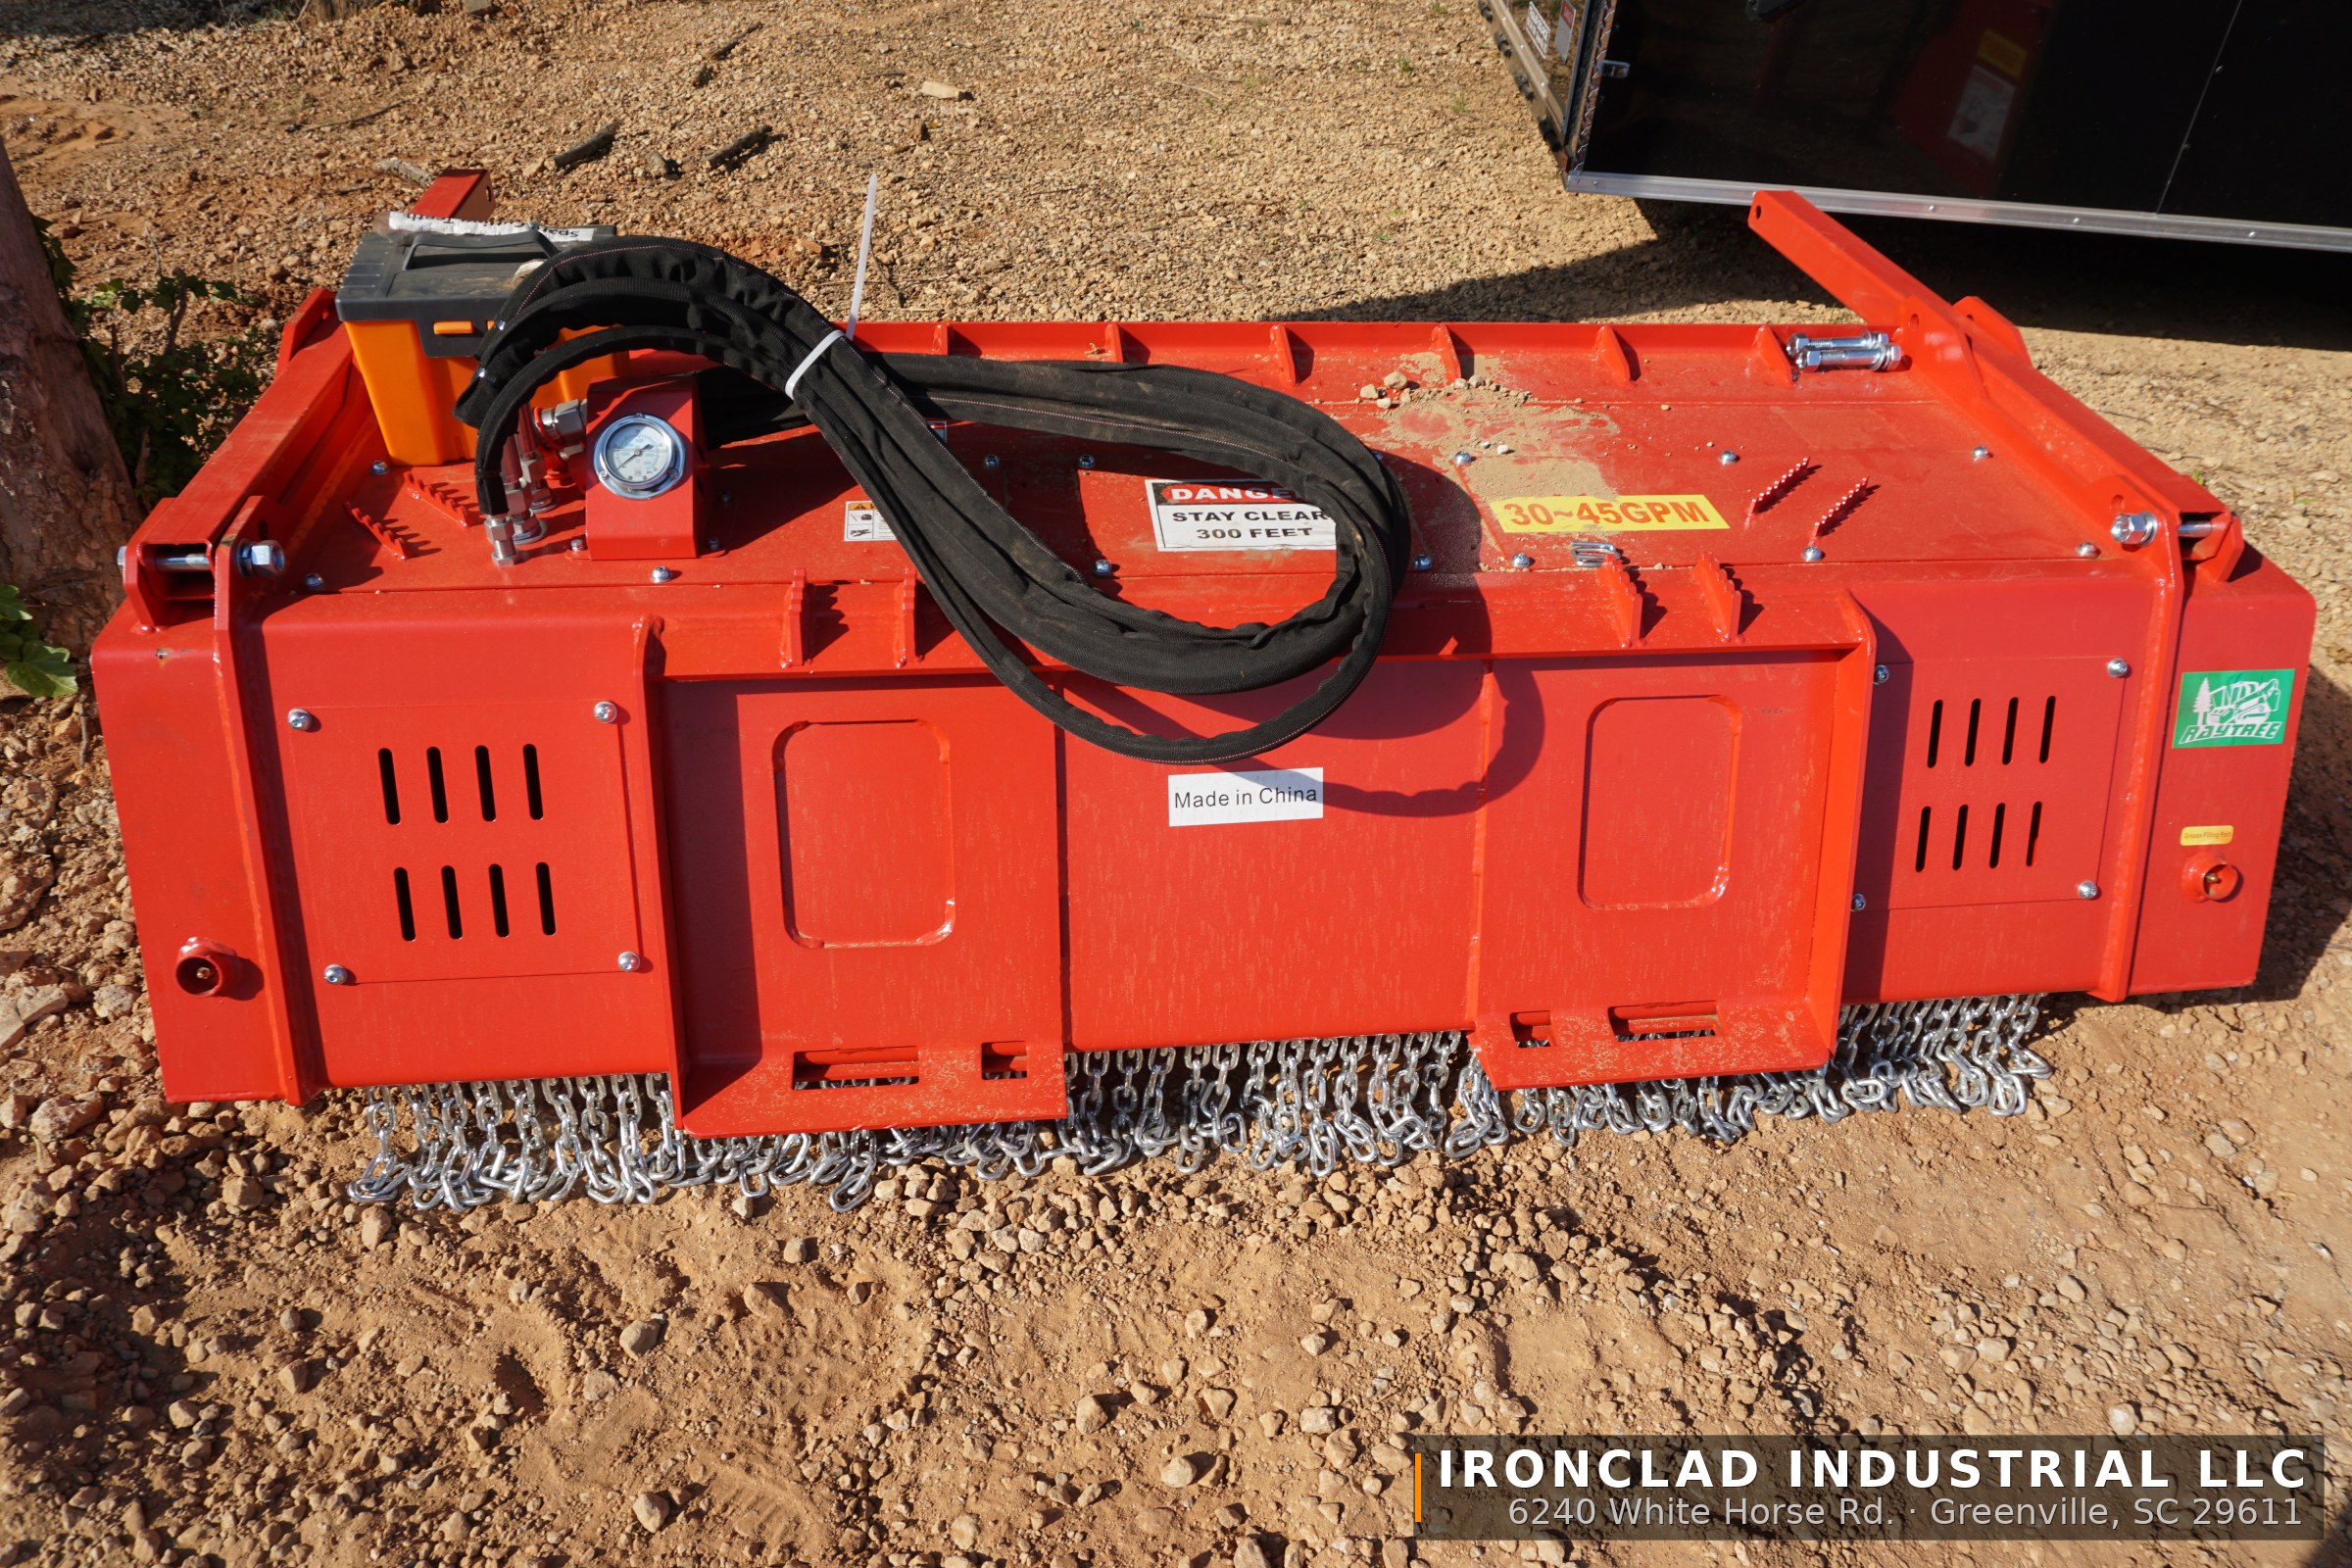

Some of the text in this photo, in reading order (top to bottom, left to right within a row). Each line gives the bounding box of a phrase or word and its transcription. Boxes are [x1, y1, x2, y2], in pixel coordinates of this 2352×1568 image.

[1170, 487, 1301, 501] DANGE
[1172, 511, 1329, 522] STAY CLEAR
[1504, 502, 1710, 526] 30~45GPM
[1197, 527, 1312, 540] 300 FEET
[1175, 786, 1317, 808] Made in China
